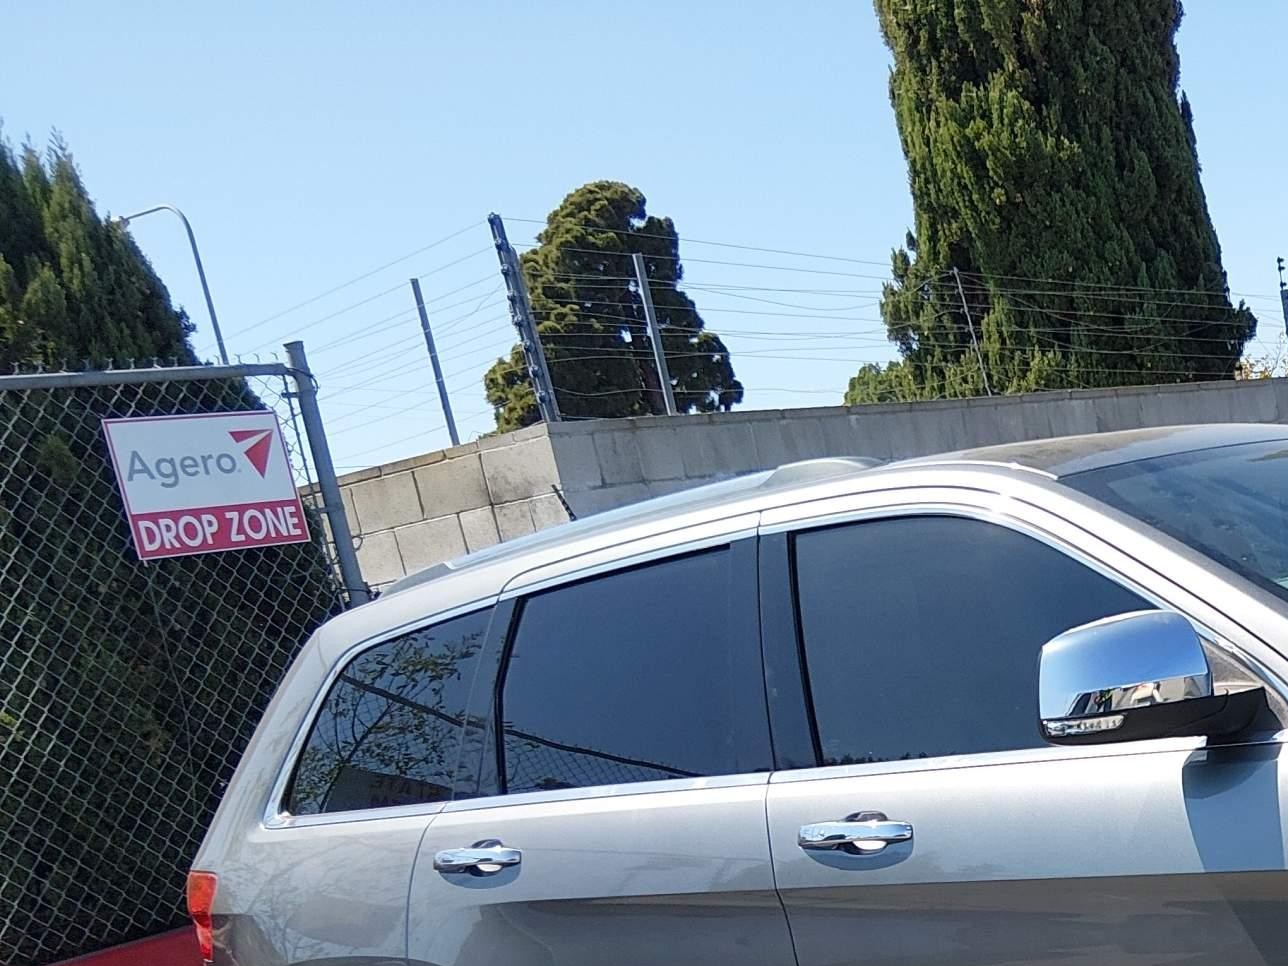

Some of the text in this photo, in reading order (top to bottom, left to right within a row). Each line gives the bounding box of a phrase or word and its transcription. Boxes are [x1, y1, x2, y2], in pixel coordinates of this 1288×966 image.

[127, 450, 237, 488] Agero
[138, 506, 301, 552] DROP ZONE
